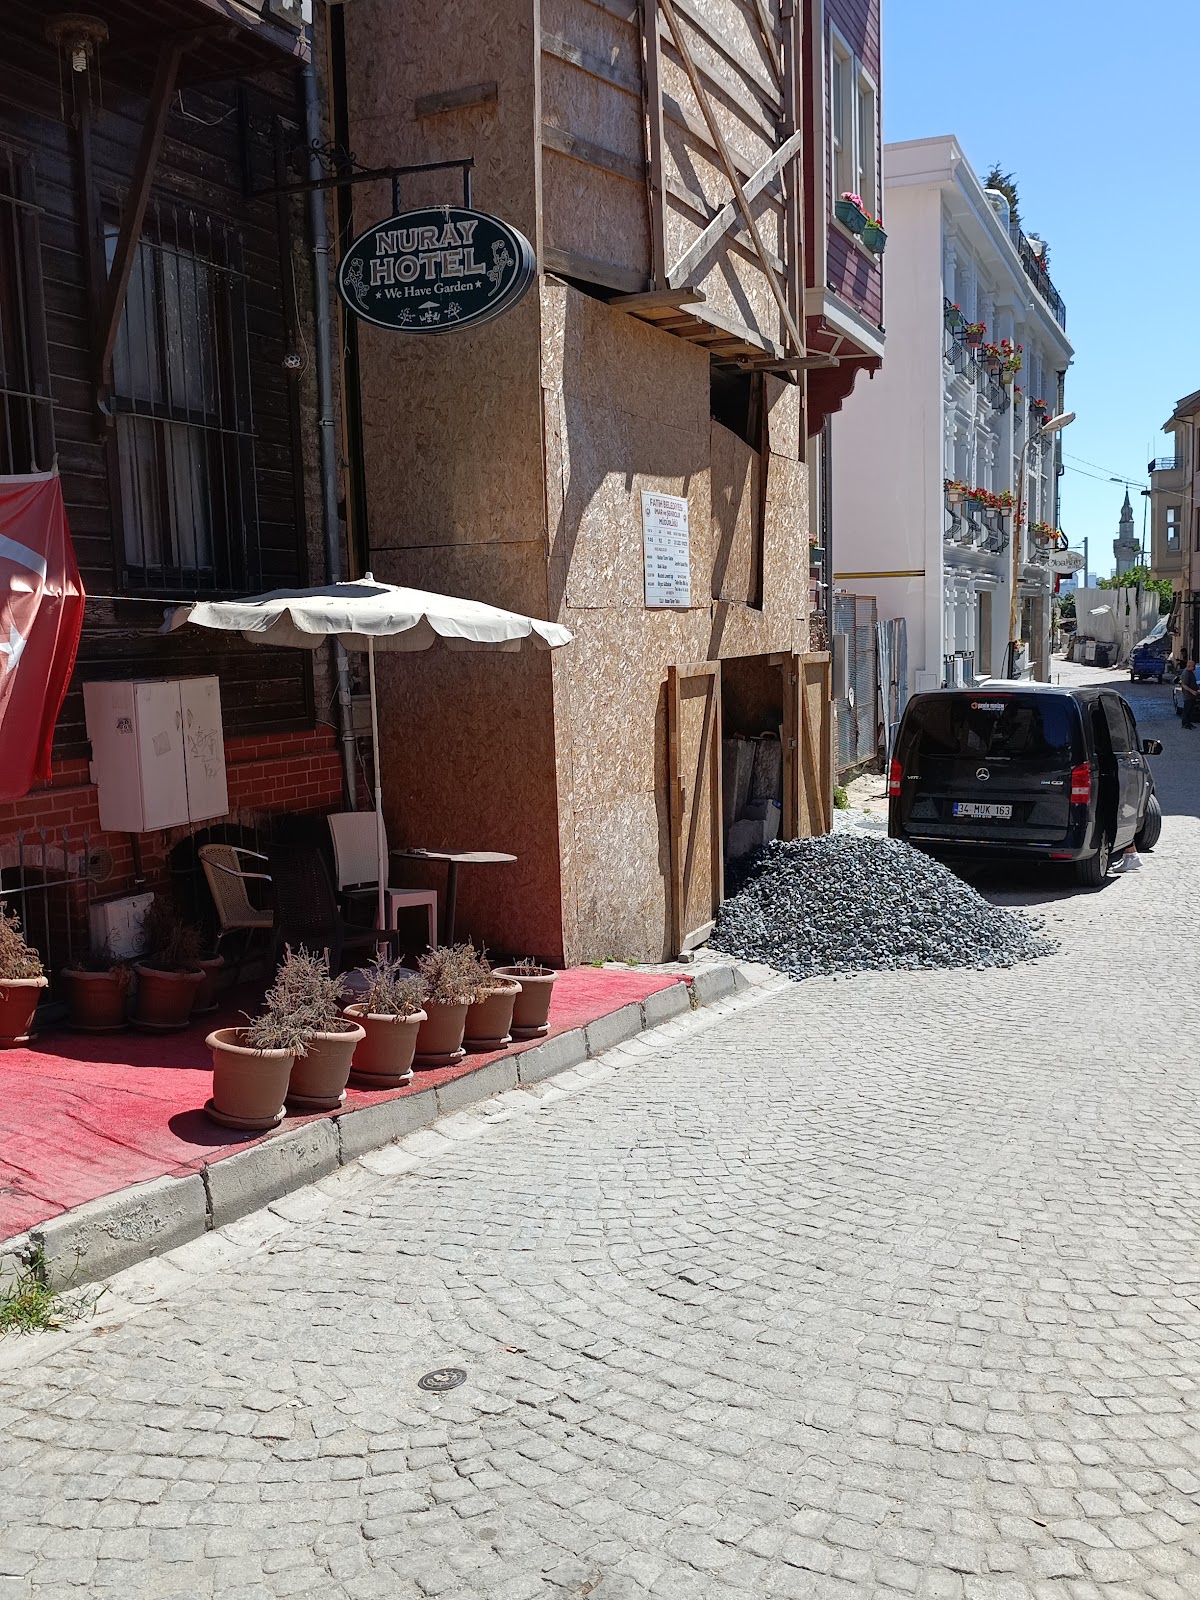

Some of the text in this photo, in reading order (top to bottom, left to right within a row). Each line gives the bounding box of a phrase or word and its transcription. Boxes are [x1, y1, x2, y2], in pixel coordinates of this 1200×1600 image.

[376, 220, 478, 256] NURAY
[370, 248, 486, 287] HOTEL
[384, 281, 474, 299] We Have Garden
[958, 803, 1011, 816] 34 MUK 163
